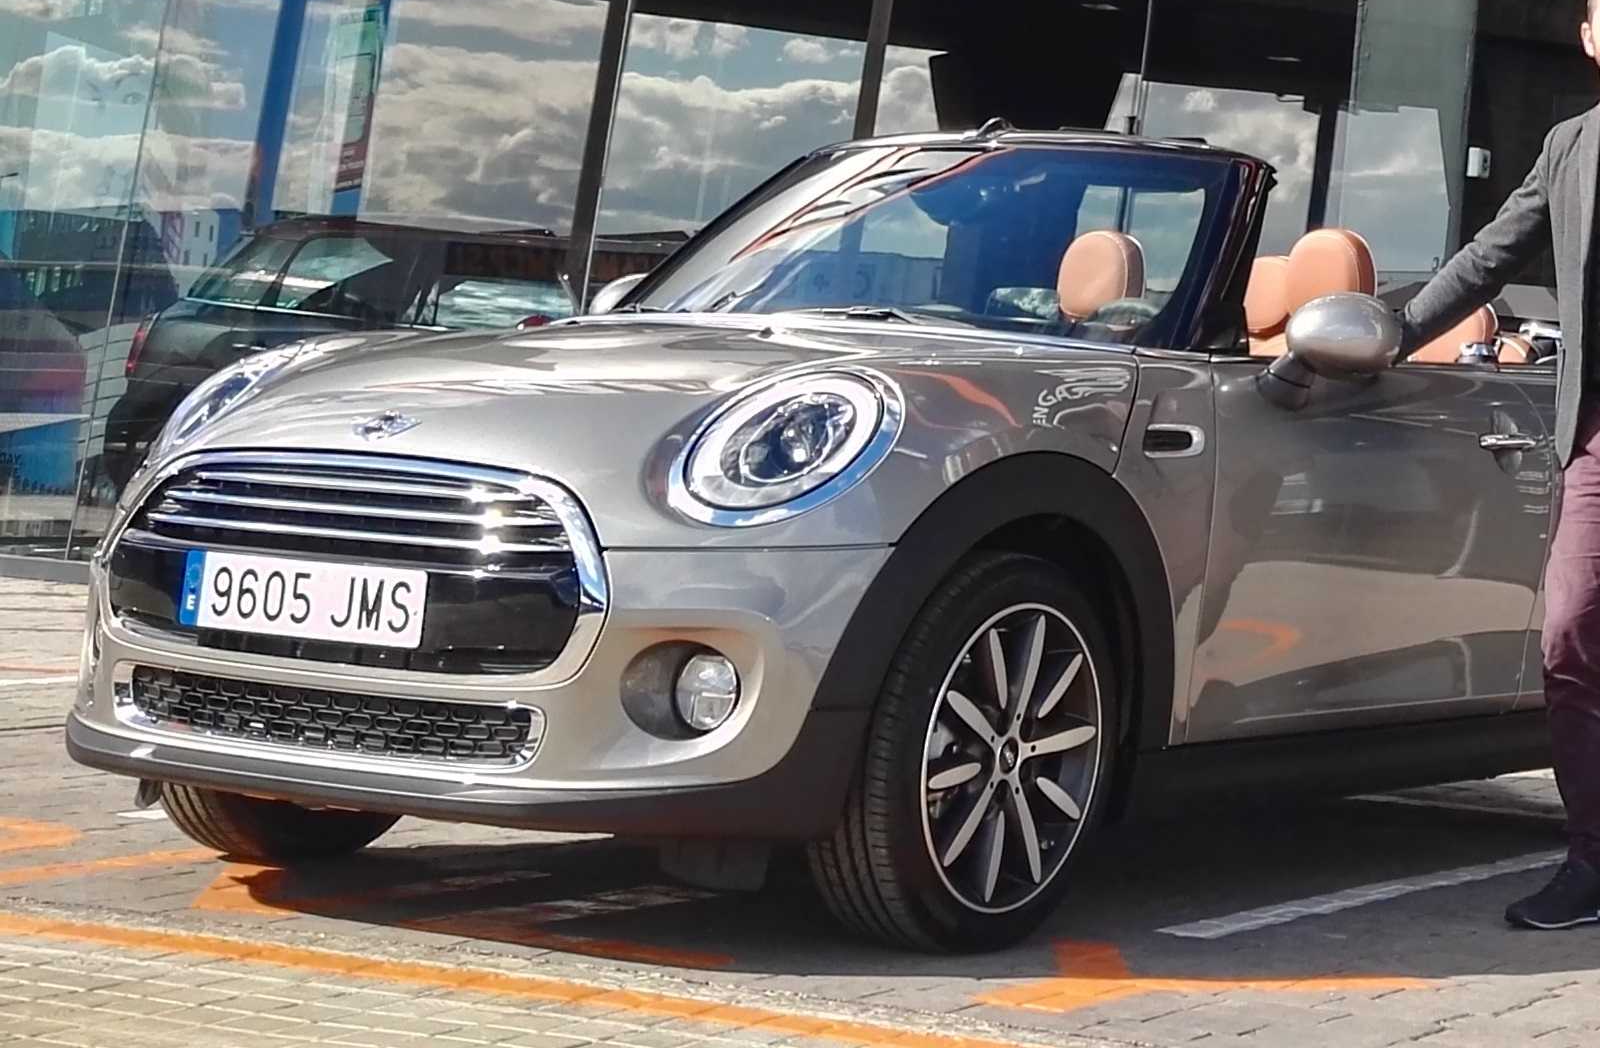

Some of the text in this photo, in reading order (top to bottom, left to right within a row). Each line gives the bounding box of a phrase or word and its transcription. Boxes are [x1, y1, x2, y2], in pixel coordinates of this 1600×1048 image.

[186, 594, 195, 610] E
[211, 566, 411, 633] 9605 JMS
